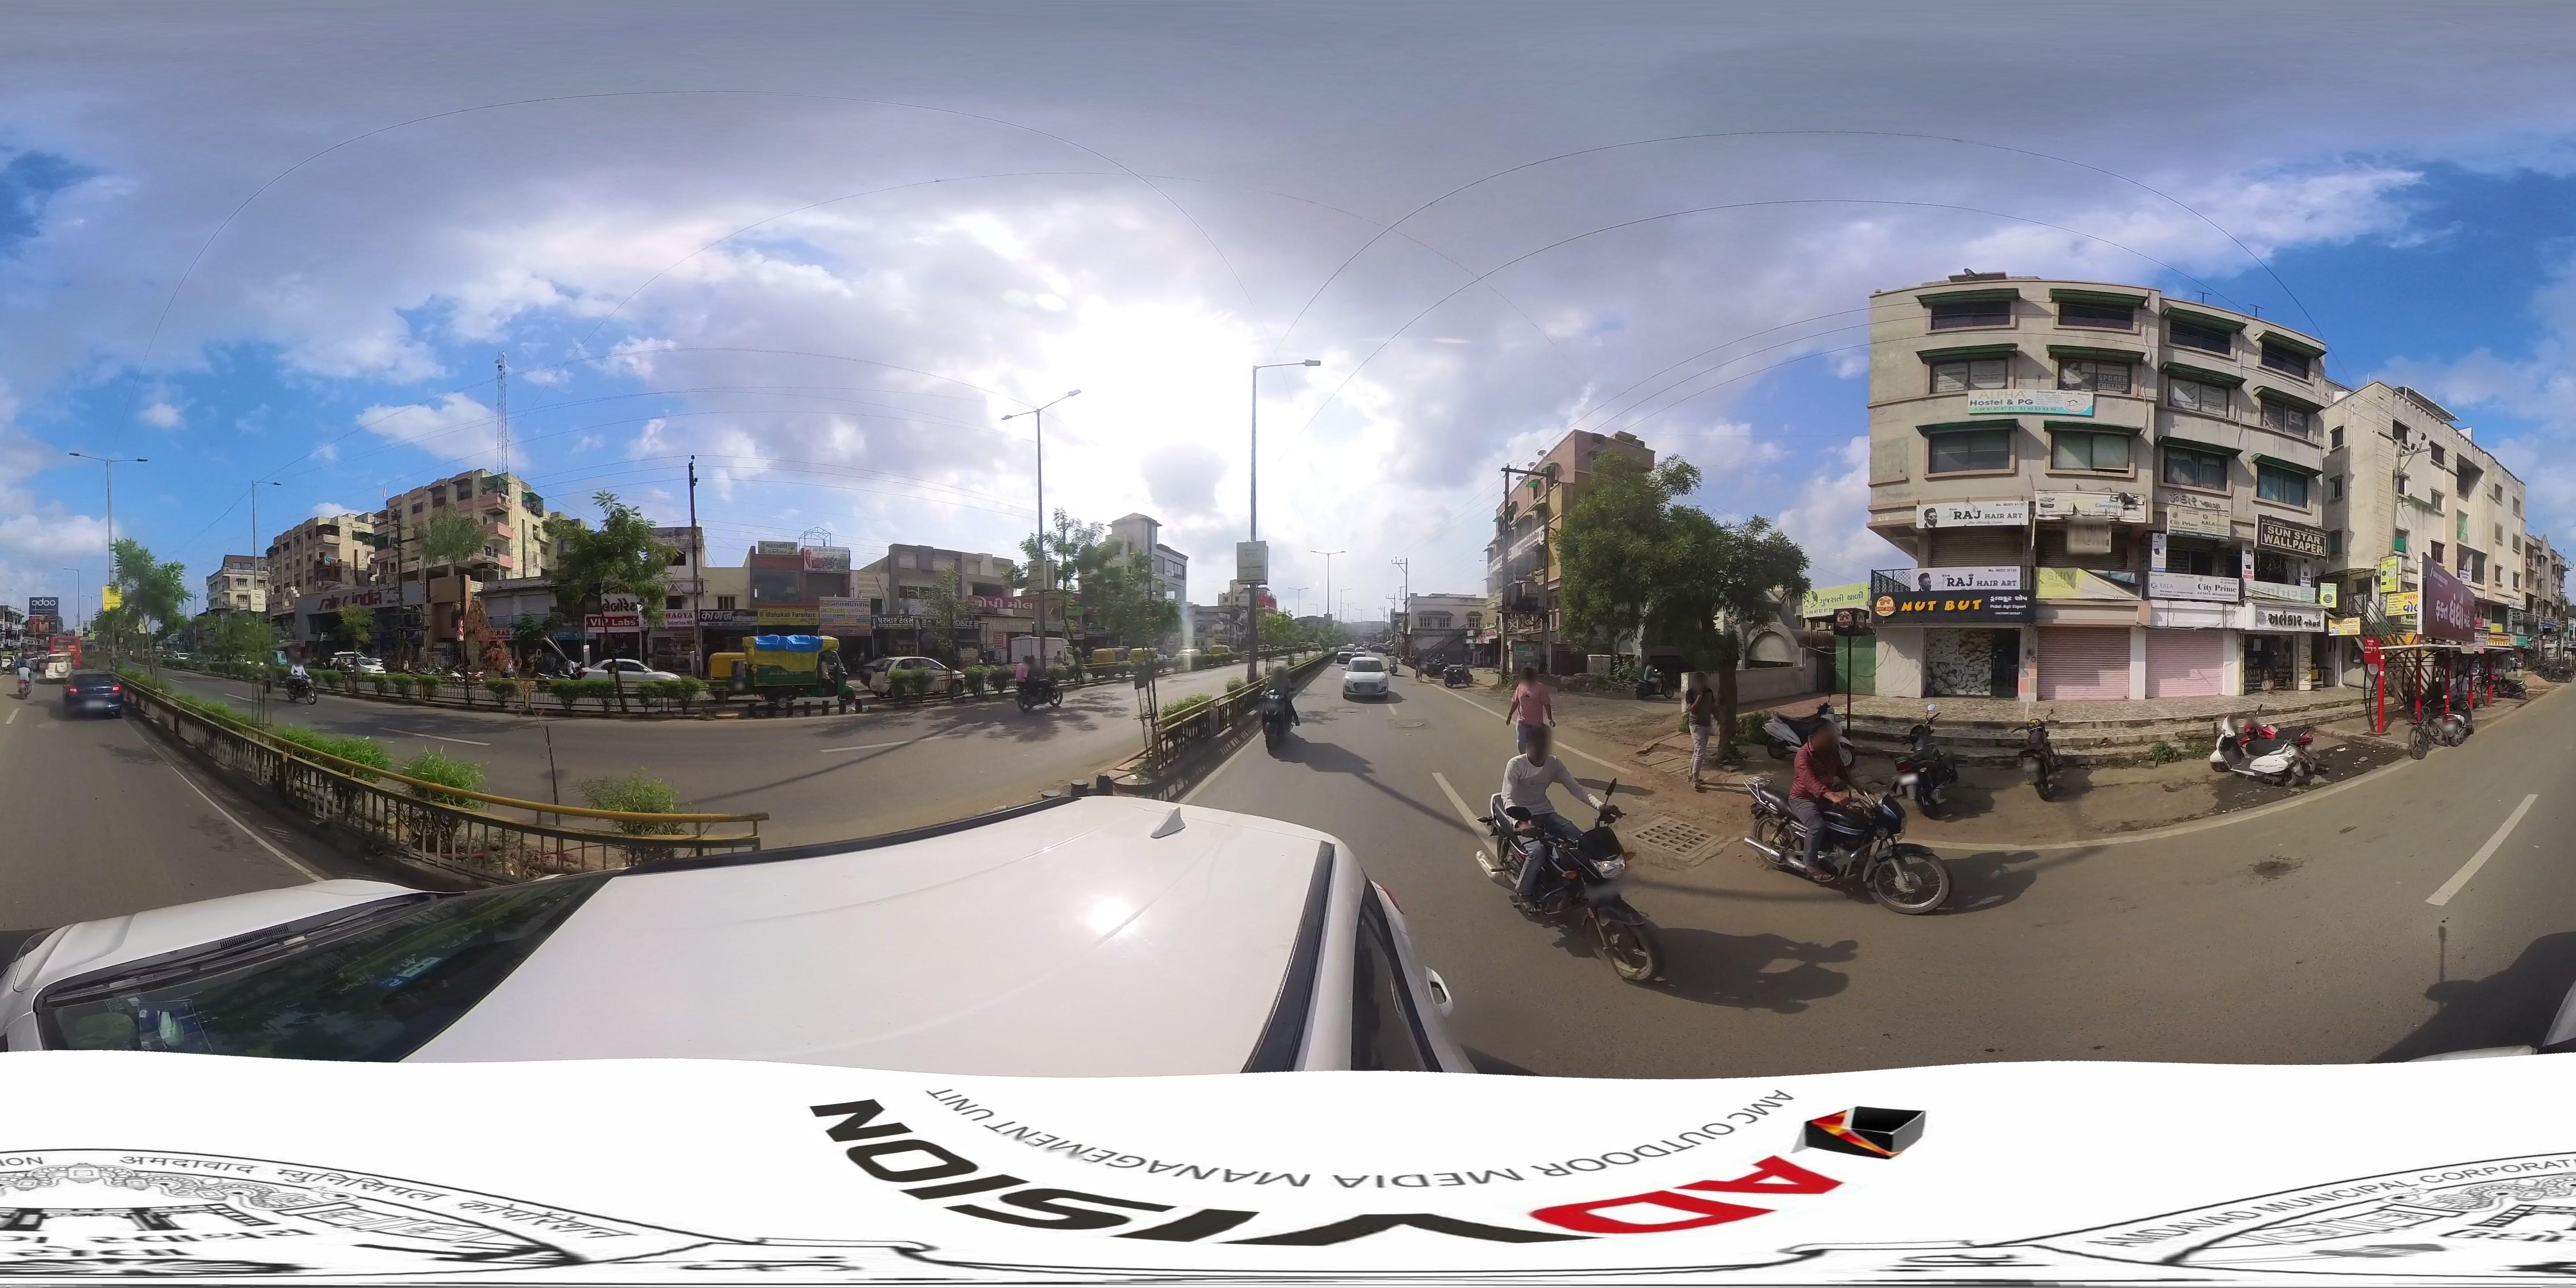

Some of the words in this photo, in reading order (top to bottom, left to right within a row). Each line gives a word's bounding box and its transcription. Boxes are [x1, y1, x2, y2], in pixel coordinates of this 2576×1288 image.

[2098, 374, 2127, 383] SPOKEN
[2097, 383, 2127, 391] ENGLISH
[1978, 390, 2026, 399] ALPHA
[1953, 510, 1982, 520] RAJ
[2267, 526, 2291, 538] SUN
[2294, 532, 2320, 545] STAR
[2263, 534, 2323, 555] WALLPAPER
[2047, 572, 2075, 580] SHIV
[1946, 577, 1974, 587] RAJ
[2197, 583, 2213, 591] City
[2215, 584, 2237, 593] Prime
[31, 598, 56, 606] odoo
[352, 589, 382, 606] india
[1819, 593, 1843, 606] ગુજરાતી
[1847, 591, 1863, 600] થાળી
[1007, 599, 1033, 610] મોલ
[1901, 601, 1937, 611] NUT
[1945, 599, 1983, 611] BUT
[590, 618, 609, 627] VIP
